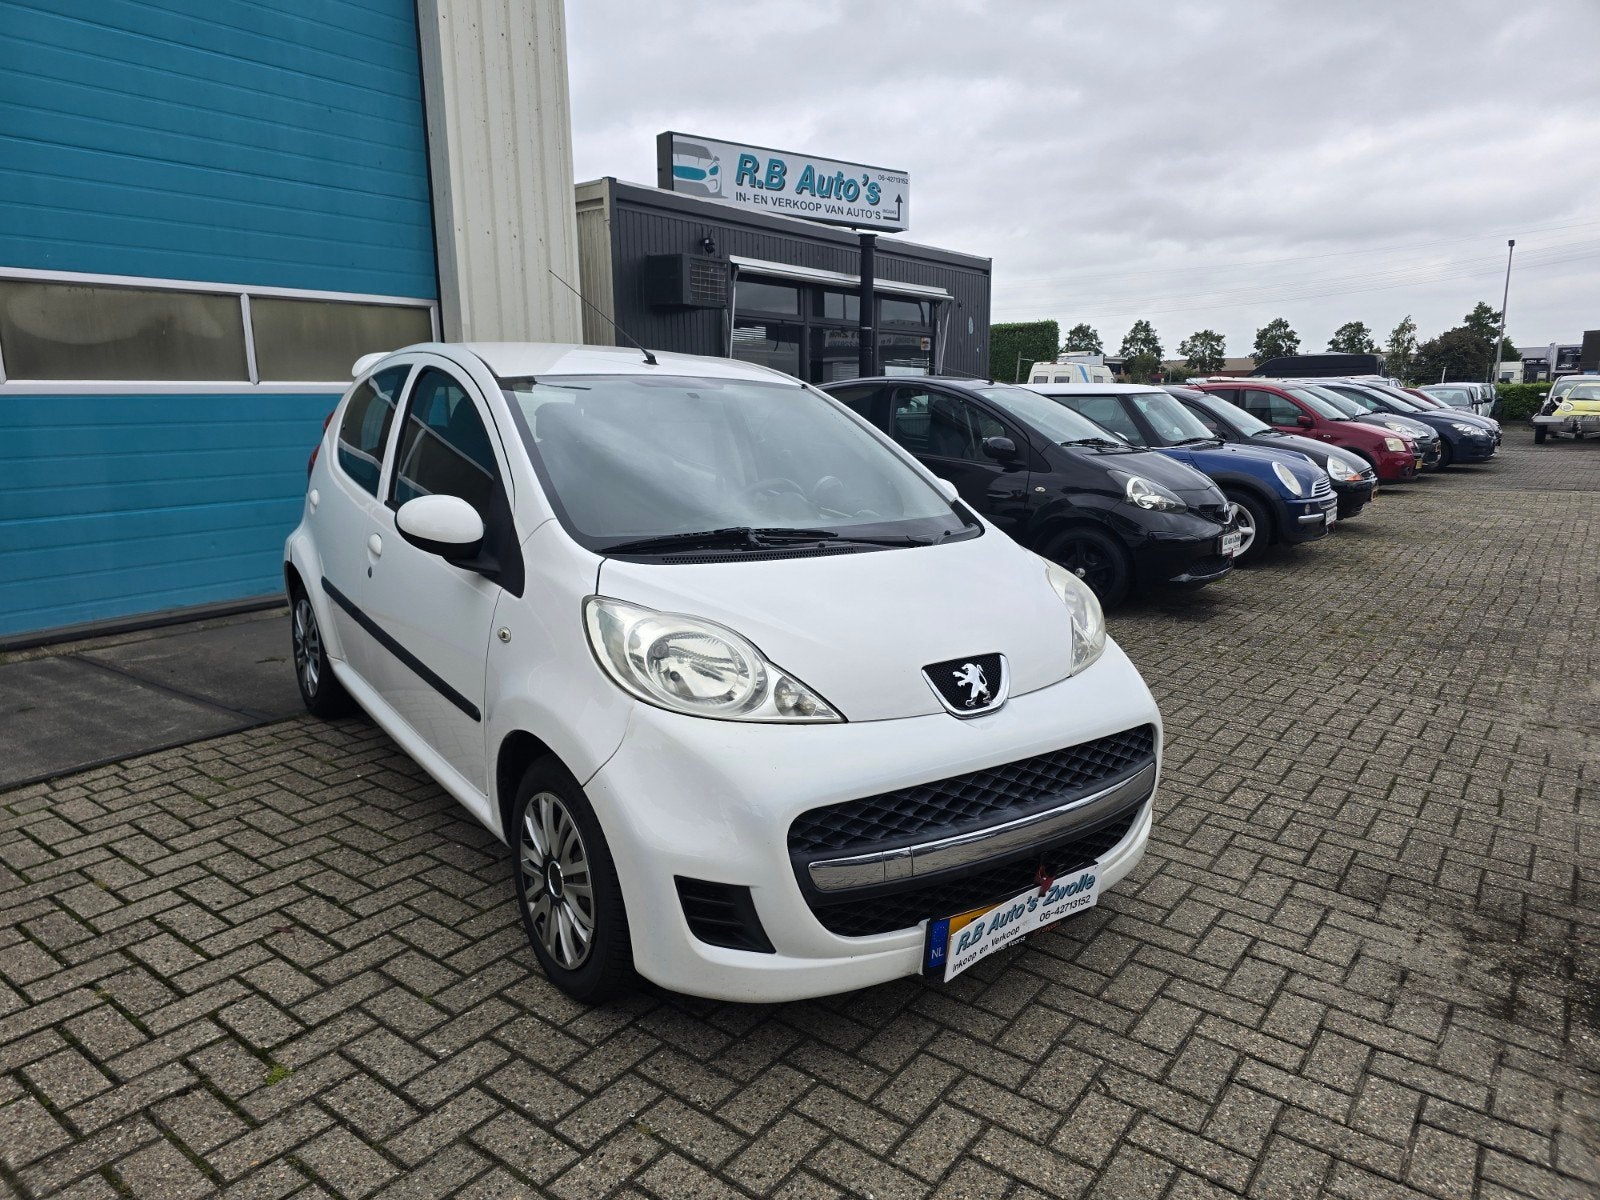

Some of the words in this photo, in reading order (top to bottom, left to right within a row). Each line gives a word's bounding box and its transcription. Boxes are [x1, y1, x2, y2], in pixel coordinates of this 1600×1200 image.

[735, 153, 787, 191] R.B
[795, 164, 881, 206] Auto's
[735, 191, 750, 202] IN-
[753, 194, 768, 205] EN
[770, 196, 822, 212] VERKOOP
[824, 203, 844, 215] VAN
[846, 207, 881, 220] AUTO'S
[955, 921, 985, 956] R.B
[986, 895, 1039, 936] Auto's
[1042, 873, 1096, 907] Zwolle
[1039, 894, 1092, 922] 06-42713152
[931, 946, 944, 960] NL
[979, 944, 989, 954] en
